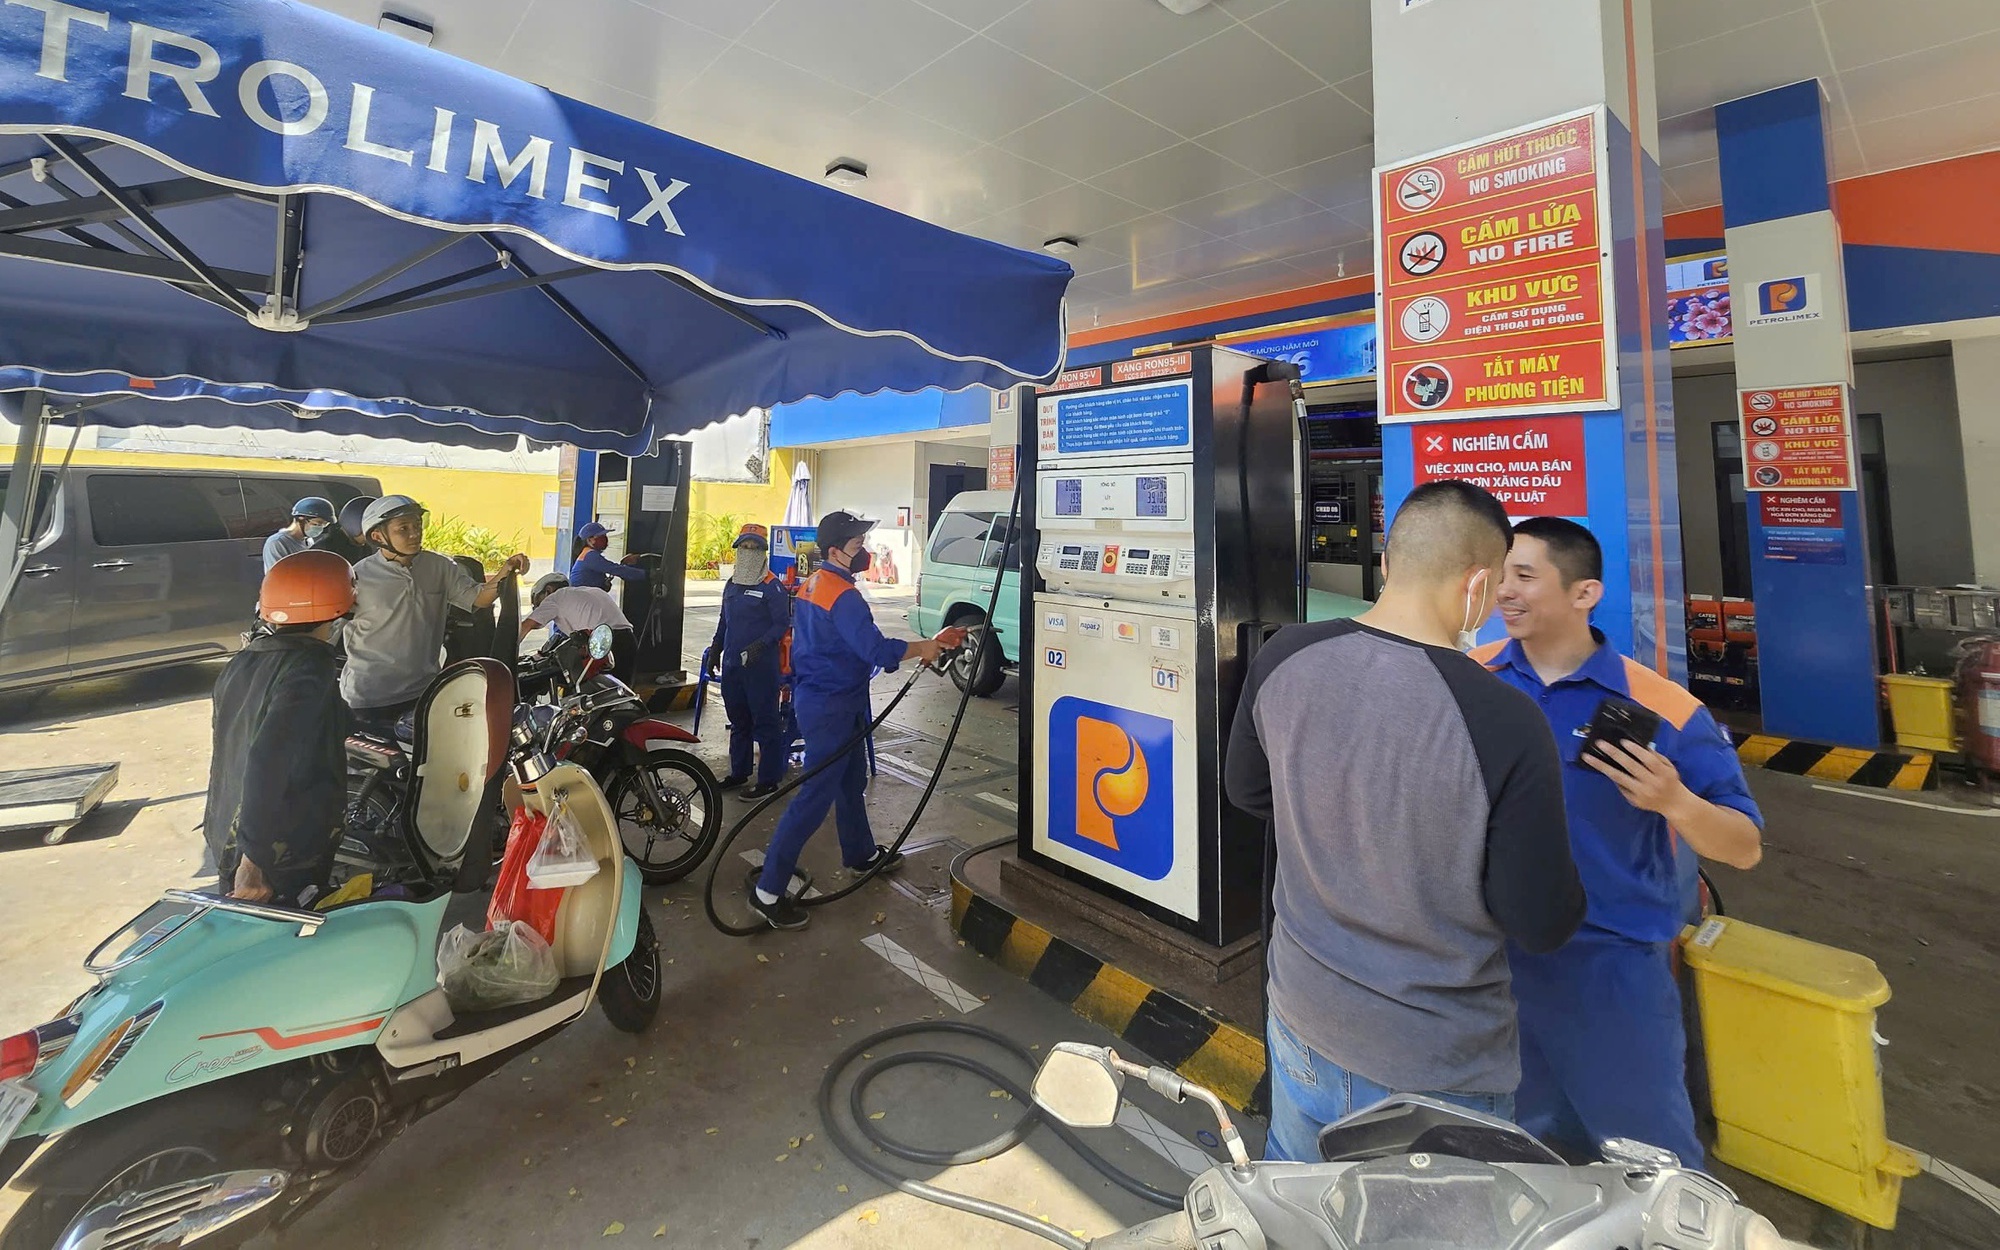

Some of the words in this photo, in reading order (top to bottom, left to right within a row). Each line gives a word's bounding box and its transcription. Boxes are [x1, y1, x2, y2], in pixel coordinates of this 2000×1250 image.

[1469, 178, 1490, 196] NO
[1494, 156, 1566, 189] SMOKING
[1461, 214, 1519, 245] CẤM
[1529, 202, 1582, 228] LỬA
[1469, 245, 1505, 265] NO
[1514, 230, 1574, 256] FIRE
[1467, 283, 1517, 308] KHU
[1525, 274, 1579, 299] VỰC
[1531, 303, 1567, 317] DỤNG
[1494, 319, 1529, 333] THOẠI
[1532, 317, 1545, 328] DI
[1548, 311, 1585, 326] ĐỘNG
[1750, 312, 1820, 326] PETROLIMEX
[1117, 361, 1142, 374] XĂNG
[1144, 355, 1186, 370] RON95-III
[1483, 355, 1515, 377] TẮT
[1519, 353, 1561, 376] MÁY
[1061, 372, 1078, 382] RON
[1465, 380, 1536, 403] PHƯƠNG
[1541, 376, 1585, 399] TIỆN
[1808, 425, 1838, 433] FIRE
[1452, 433, 1511, 452] NGHIÊM
[1512, 429, 1549, 450] CẤM
[1784, 440, 1810, 449] KHU
[1425, 462, 1451, 476] VIỆC
[1453, 463, 1474, 474] XIN
[1475, 462, 1506, 474] CHO,
[1508, 461, 1539, 472] MUA
[1542, 459, 1572, 472] BÁN
[1493, 474, 1529, 488] XĂNG
[1532, 472, 1562, 487] DẦU
[1515, 489, 1547, 505] LUẬT
[1048, 616, 1064, 627] VISA
[1048, 650, 1063, 666] 02
[1157, 671, 1174, 688] 01
